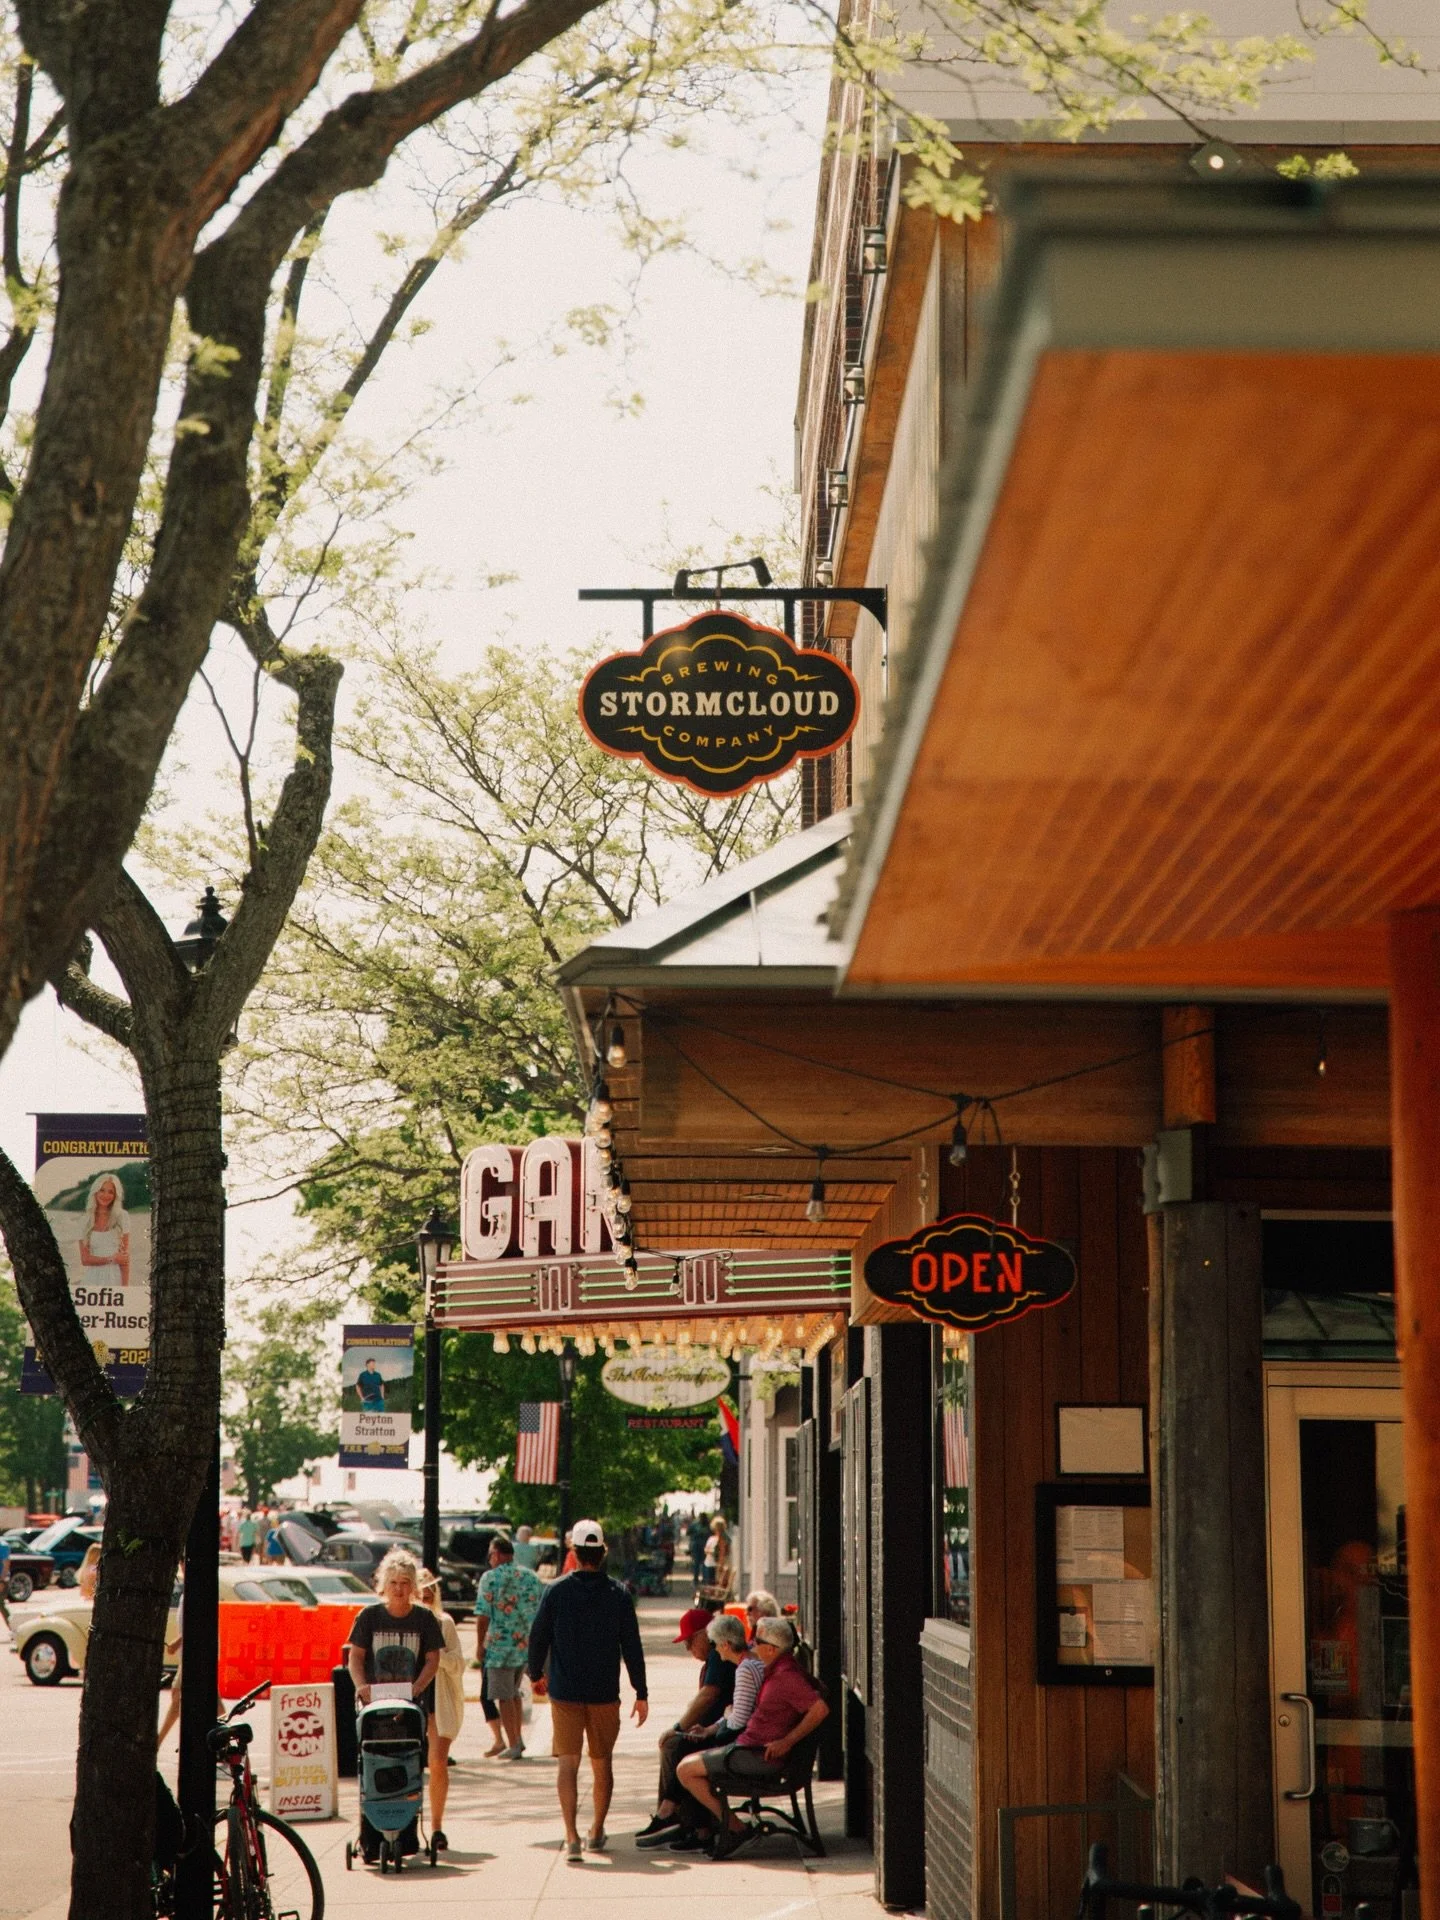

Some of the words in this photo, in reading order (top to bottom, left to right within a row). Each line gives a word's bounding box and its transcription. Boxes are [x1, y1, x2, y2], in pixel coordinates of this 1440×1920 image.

[662, 660, 779, 686] BREWING
[599, 690, 840, 717] STORMCLOUD
[662, 724, 775, 748] COMPANY
[912, 1252, 1022, 1293] OPEN
[74, 1287, 124, 1307] Sofia
[80, 1311, 150, 1329] er-Rusc
[359, 1413, 393, 1426] Peyton
[354, 1425, 396, 1436] Stratton
[280, 1691, 321, 1711] fresh
[279, 1715, 324, 1739] POP
[276, 1735, 325, 1756] CORN
[279, 1794, 322, 1806] INSIDE
